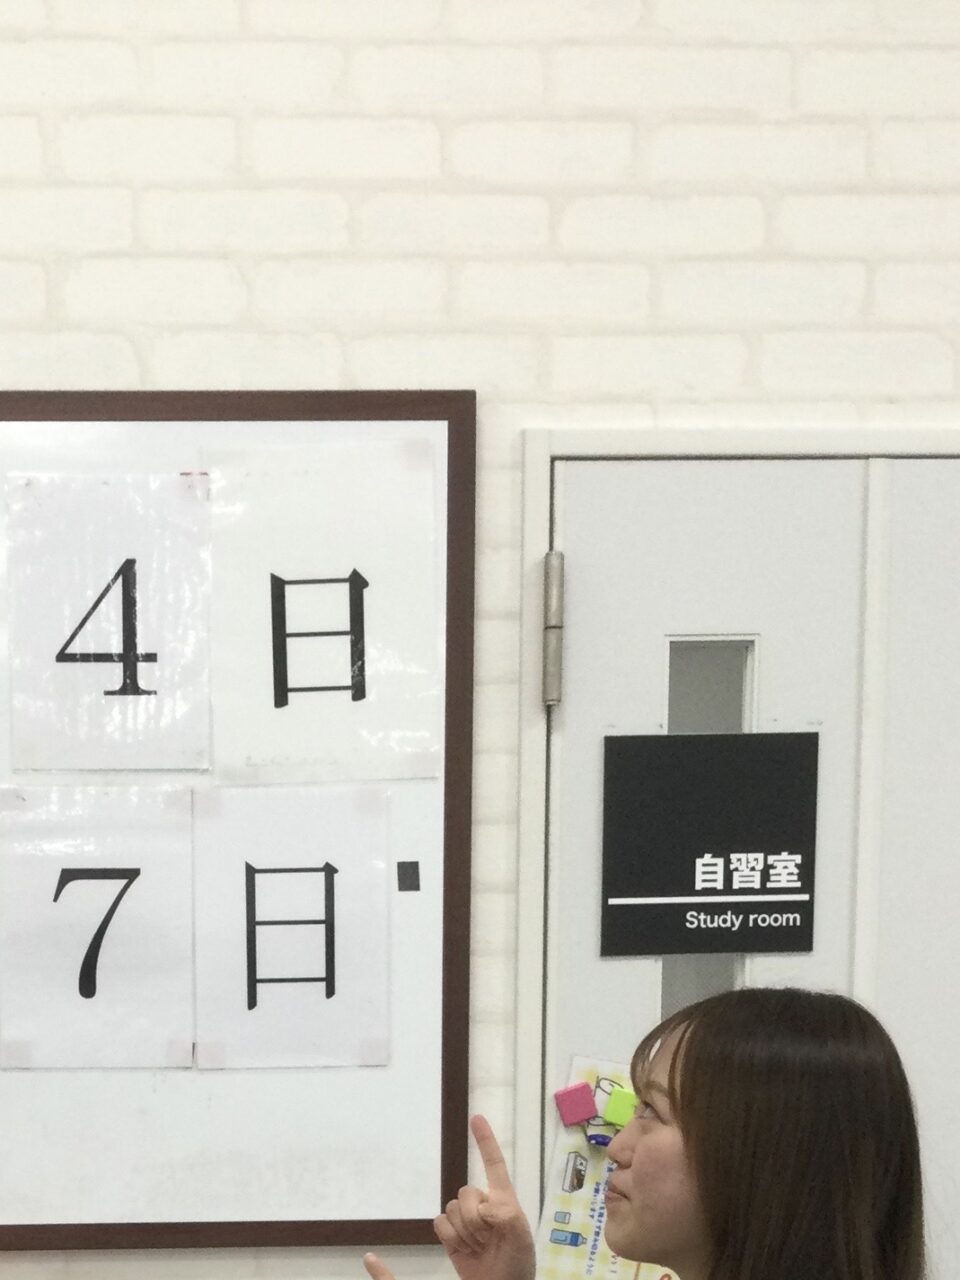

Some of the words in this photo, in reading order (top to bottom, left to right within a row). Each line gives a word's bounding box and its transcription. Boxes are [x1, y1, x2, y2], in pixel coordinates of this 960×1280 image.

[695, 852, 802, 890] 自習室
[685, 910, 743, 930] Study
[749, 911, 801, 928] room
